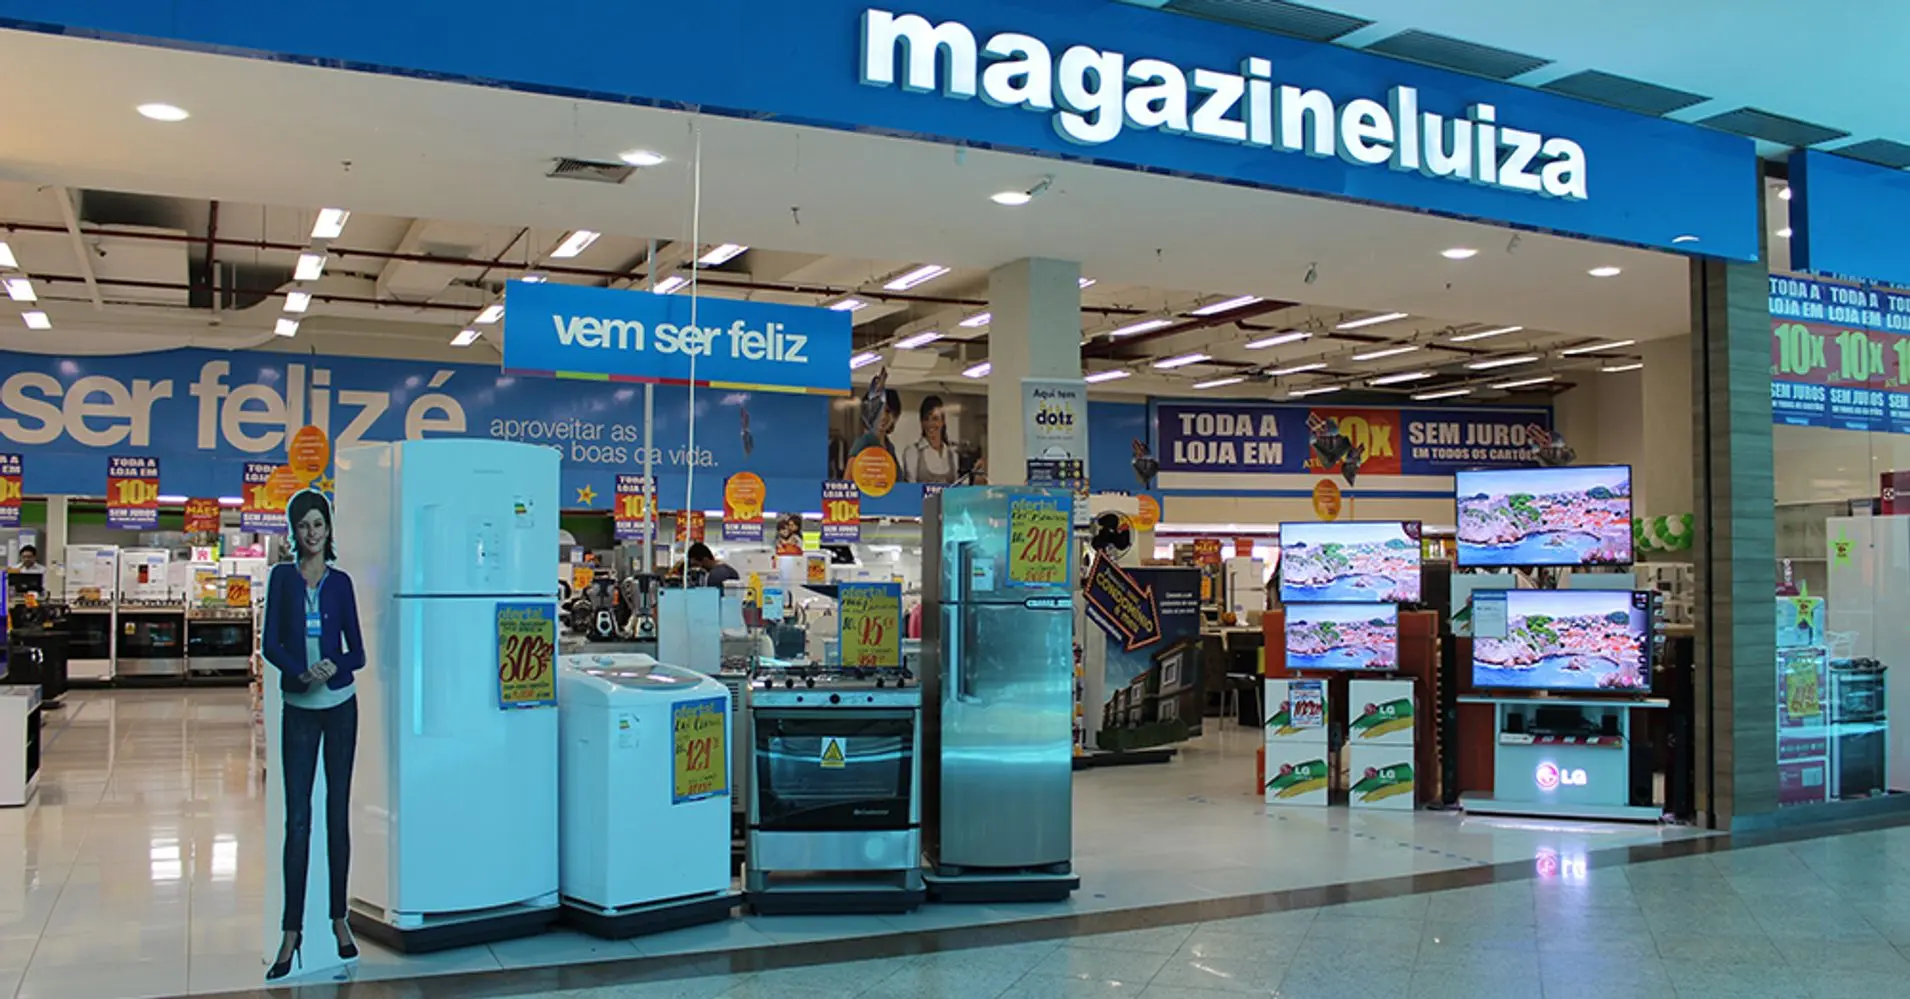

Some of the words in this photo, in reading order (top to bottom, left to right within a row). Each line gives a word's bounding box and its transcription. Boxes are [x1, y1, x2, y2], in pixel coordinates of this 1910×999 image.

[860, 8, 1588, 200] magazineluiza
[1769, 278, 1808, 298] TODA
[1810, 284, 1820, 300] A
[1829, 286, 1867, 307] TODA
[1869, 293, 1879, 308] A
[1769, 297, 1800, 316] LOJA
[1803, 302, 1824, 319] EM
[1828, 305, 1860, 324] LOJA
[1862, 310, 1881, 327] EM
[553, 314, 644, 350] vem
[654, 321, 721, 357] ser
[728, 319, 808, 363] feliz
[1033, 389, 1055, 400] Aqui
[1830, 388, 1851, 404] SEM
[0, 371, 173, 447] ser
[190, 360, 391, 452] feliz
[404, 369, 467, 440] é
[1036, 409, 1073, 425] dotz
[490, 418, 604, 442] aproveitar
[611, 424, 638, 442] as
[1178, 413, 1254, 437] TODA
[1259, 415, 1278, 437] A
[1408, 422, 1460, 445] SEM
[1465, 424, 1536, 447] JURO
[571, 442, 627, 464] boas
[669, 445, 719, 467] vida.
[1174, 440, 1237, 464] LOJA
[1243, 442, 1283, 464] EM
[1413, 448, 1430, 459] EM
[1433, 448, 1470, 459] TODOS
[1473, 449, 1488, 459] OS
[1379, 705, 1396, 715] LG
[1295, 766, 1311, 775] LG
[1379, 769, 1396, 779] LG
[1560, 768, 1588, 786] LG
